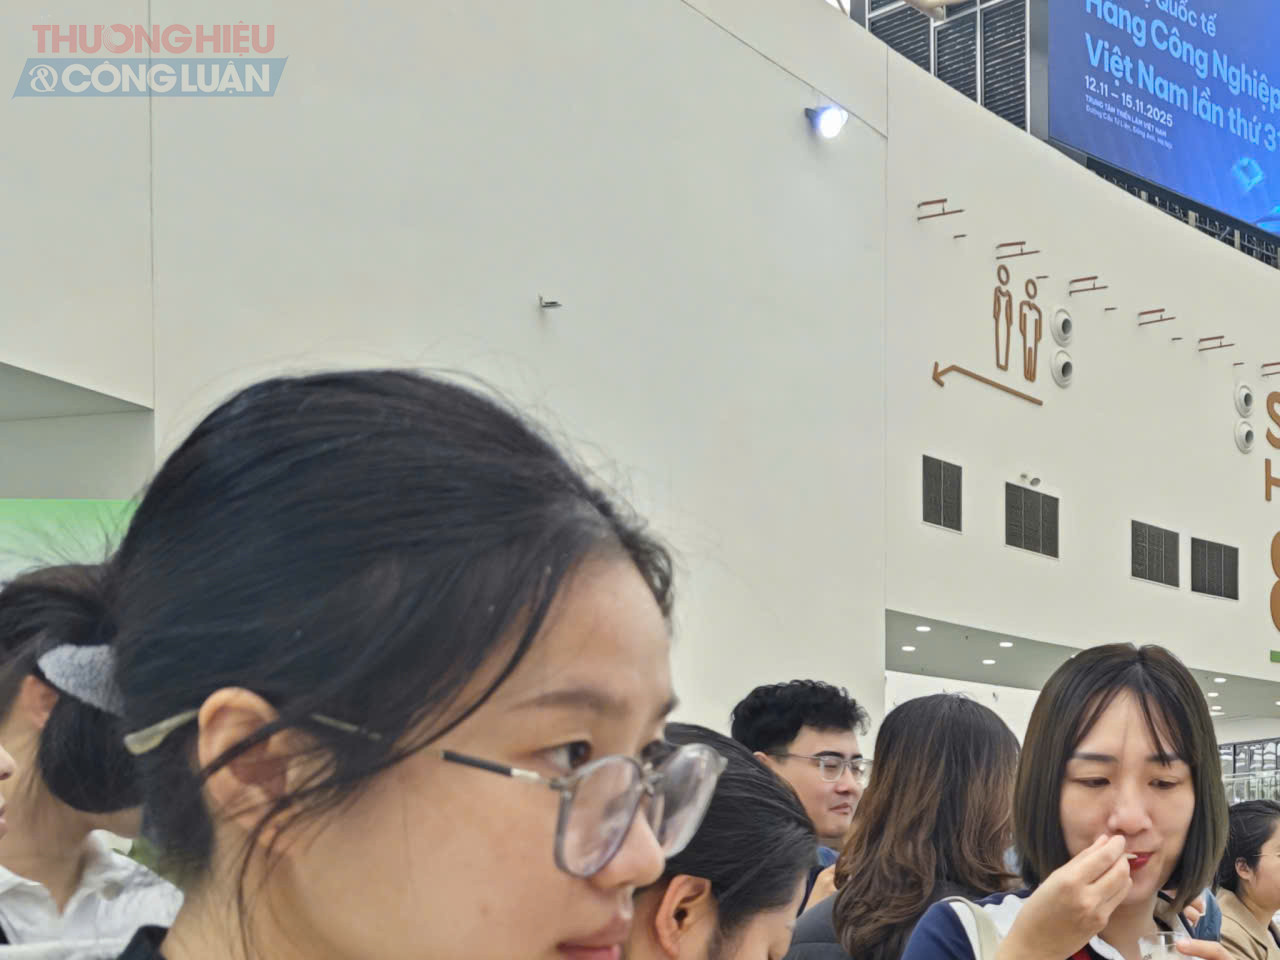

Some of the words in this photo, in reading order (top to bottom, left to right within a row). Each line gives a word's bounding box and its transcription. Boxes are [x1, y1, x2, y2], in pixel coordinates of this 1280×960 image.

[1151, 19, 1209, 79] Công
[1200, 12, 1218, 37] tế
[1085, 33, 1133, 86] Việt
[1138, 59, 1188, 111] Nam
[1192, 85, 1224, 128] lần
[1228, 107, 1262, 145] thứ
[1085, 75, 1108, 97] 12.11
[1121, 92, 1173, 128] 15.11.2025
